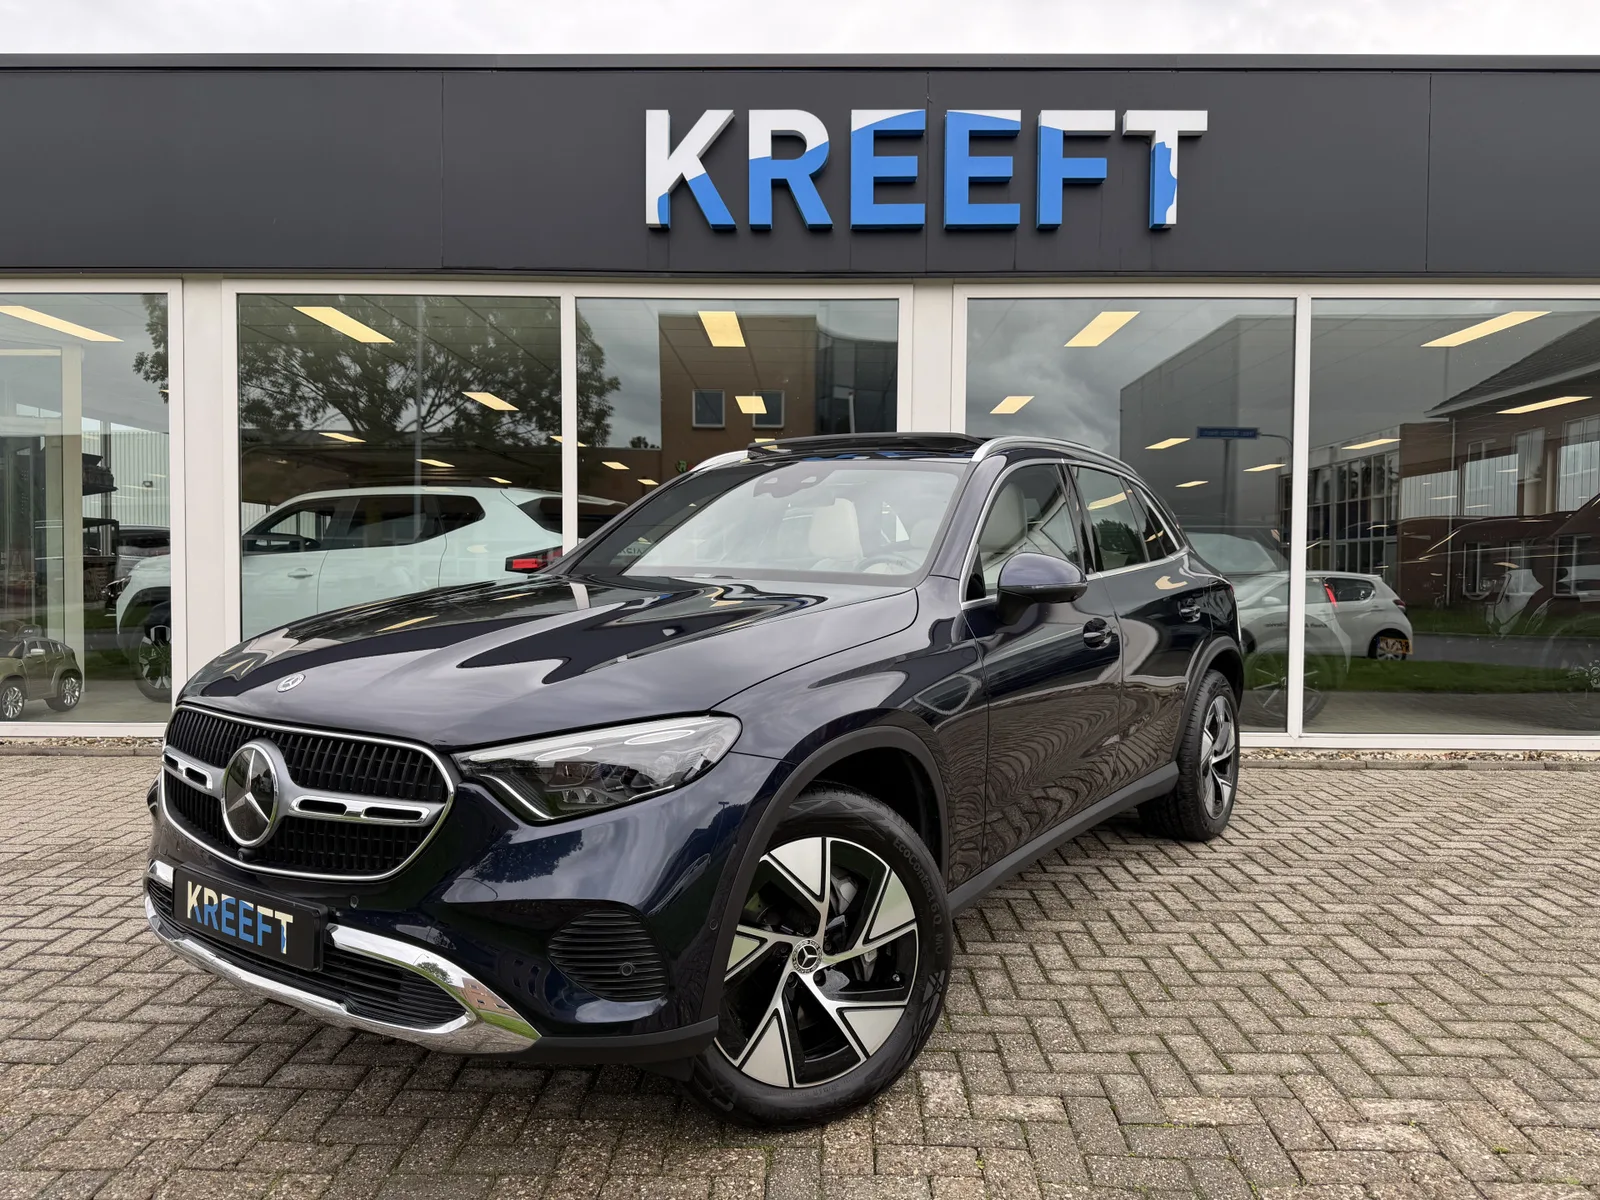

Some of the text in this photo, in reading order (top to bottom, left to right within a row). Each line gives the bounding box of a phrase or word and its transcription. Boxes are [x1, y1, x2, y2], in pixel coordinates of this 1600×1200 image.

[645, 108, 1208, 230] KREEFT
[893, 837, 936, 902] EcoContact
[187, 880, 294, 955] KREEFT
